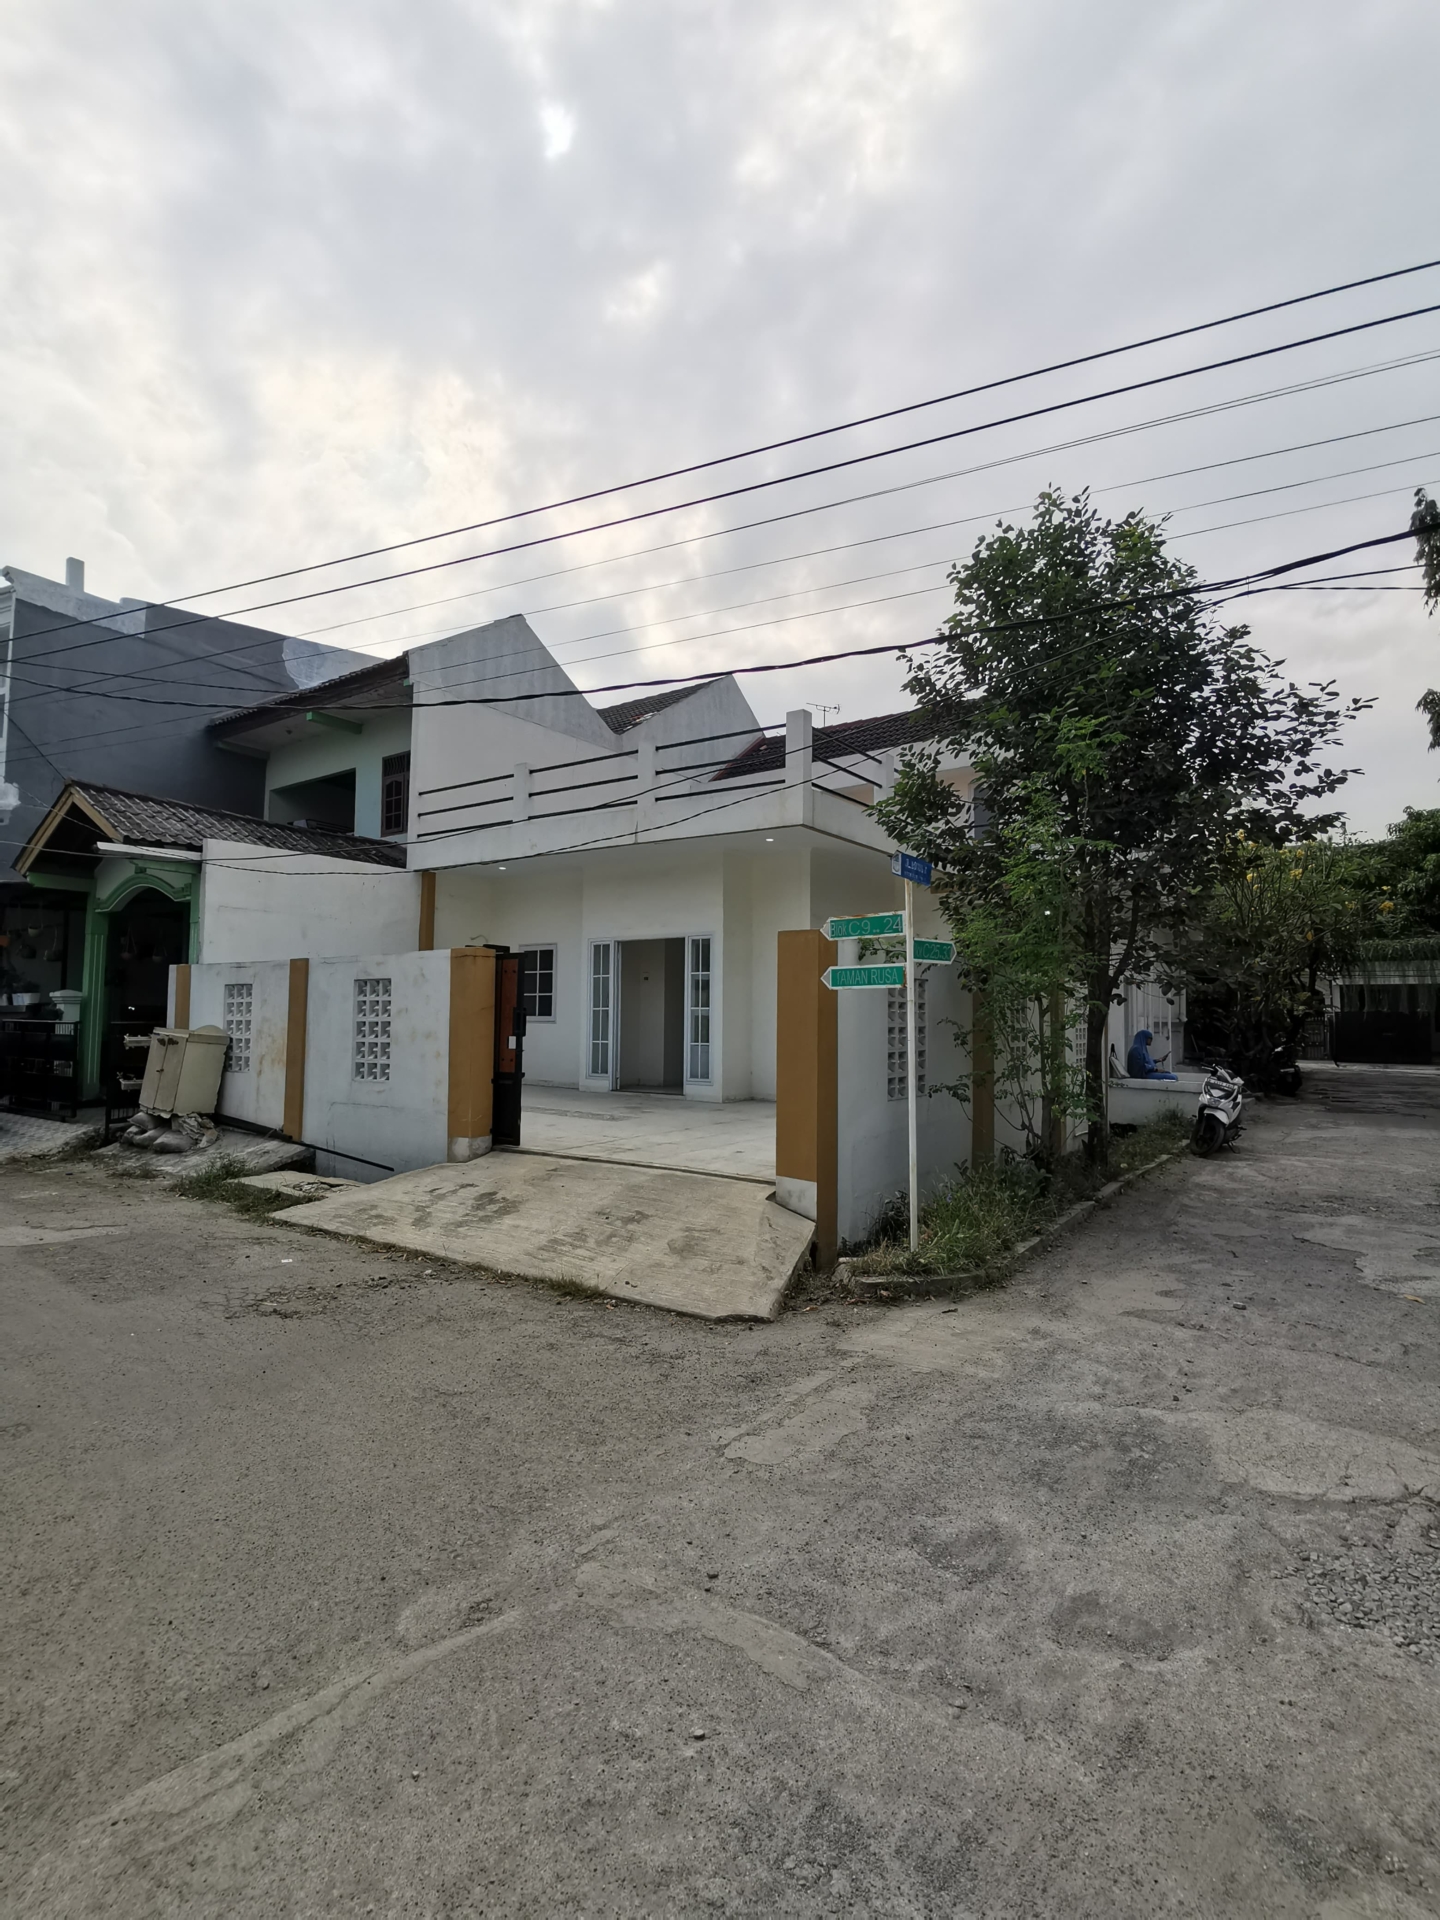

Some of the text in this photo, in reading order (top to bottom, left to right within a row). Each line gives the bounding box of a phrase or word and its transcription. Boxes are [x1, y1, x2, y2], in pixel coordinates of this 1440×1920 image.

[830, 922, 848, 937] Blok
[836, 967, 899, 985] TAMAN RUSA
